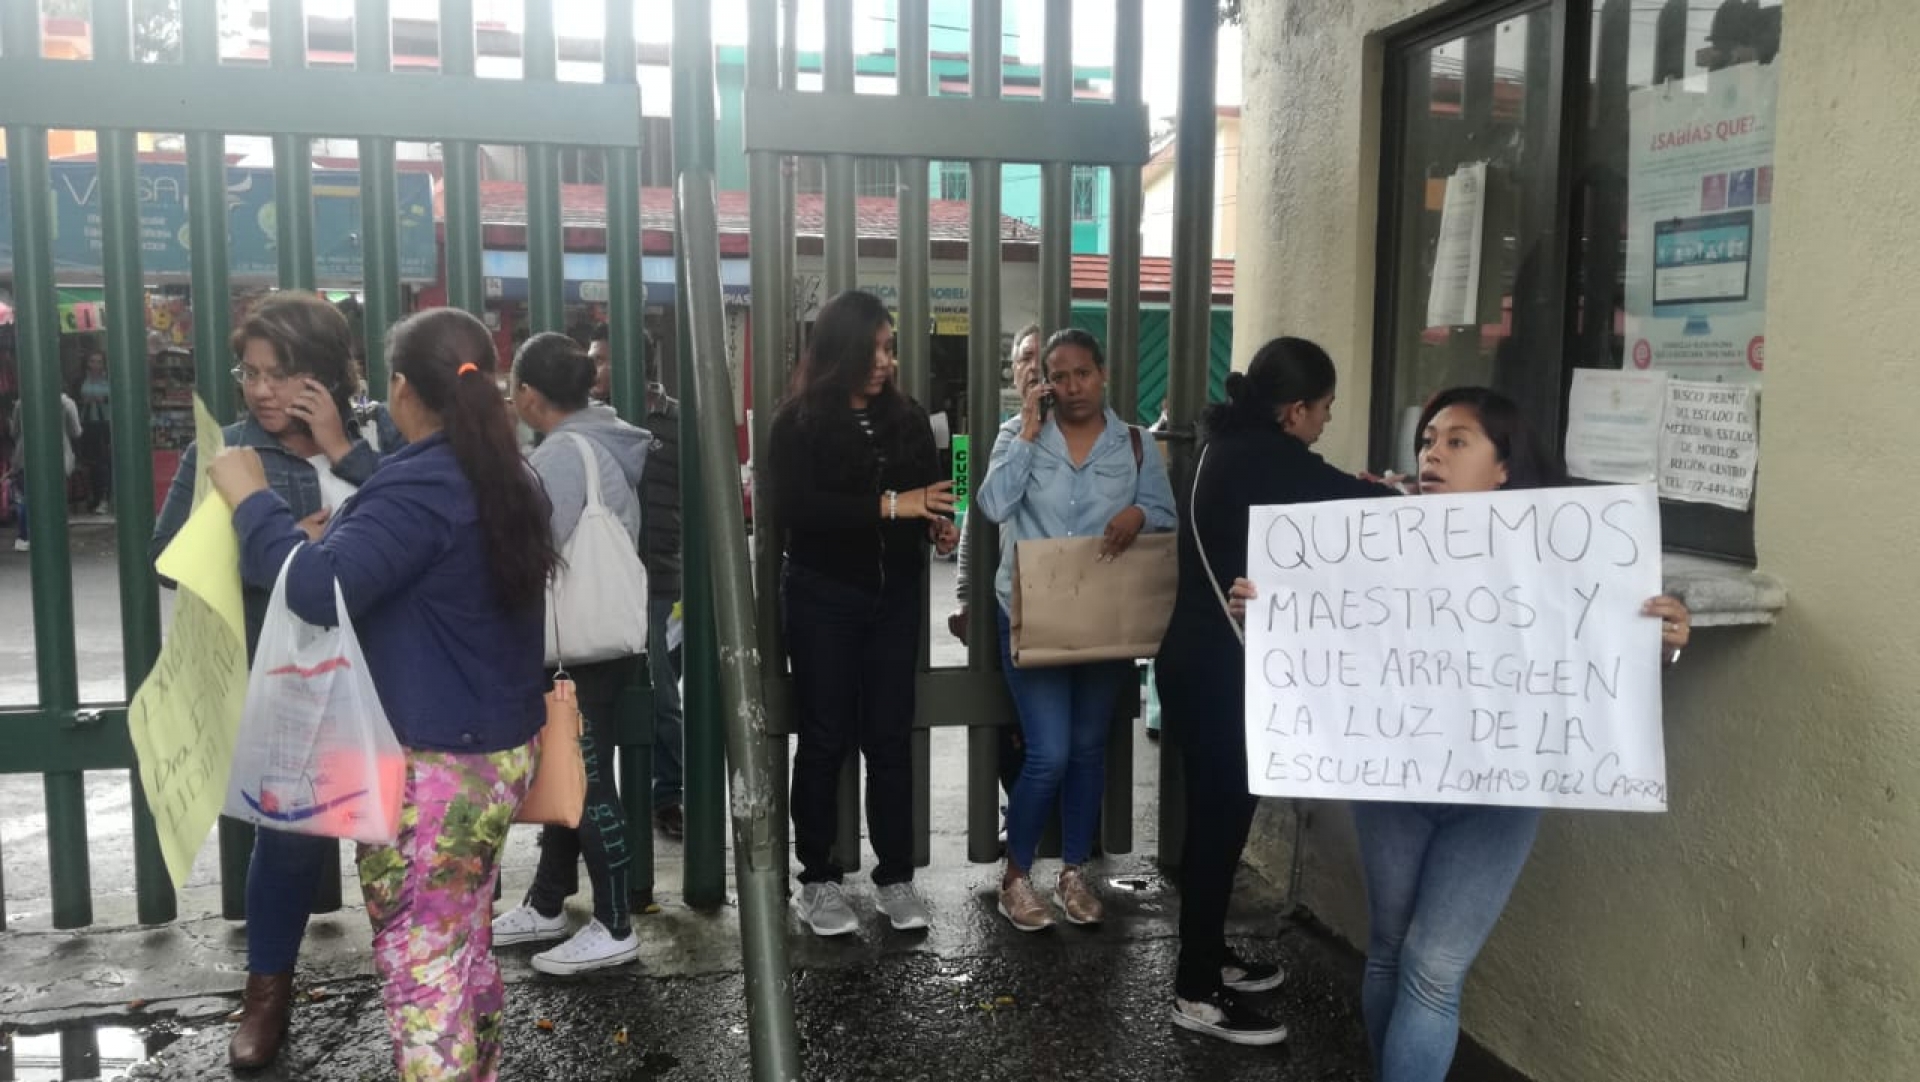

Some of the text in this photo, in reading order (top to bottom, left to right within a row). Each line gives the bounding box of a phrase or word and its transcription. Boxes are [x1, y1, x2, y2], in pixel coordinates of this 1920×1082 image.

[62, 174, 180, 205] VSA
[723, 292, 752, 305] PIAS
[955, 449, 968, 496] CURP
[1265, 500, 1639, 571] QUEREMOS
[1267, 580, 1600, 640] MAESTROS Y
[1263, 649, 1360, 690] QUE
[1265, 703, 1594, 756] LA LUZ DE LA
[1265, 751, 1422, 790] ESCUELA
[586, 803, 633, 870] girl
